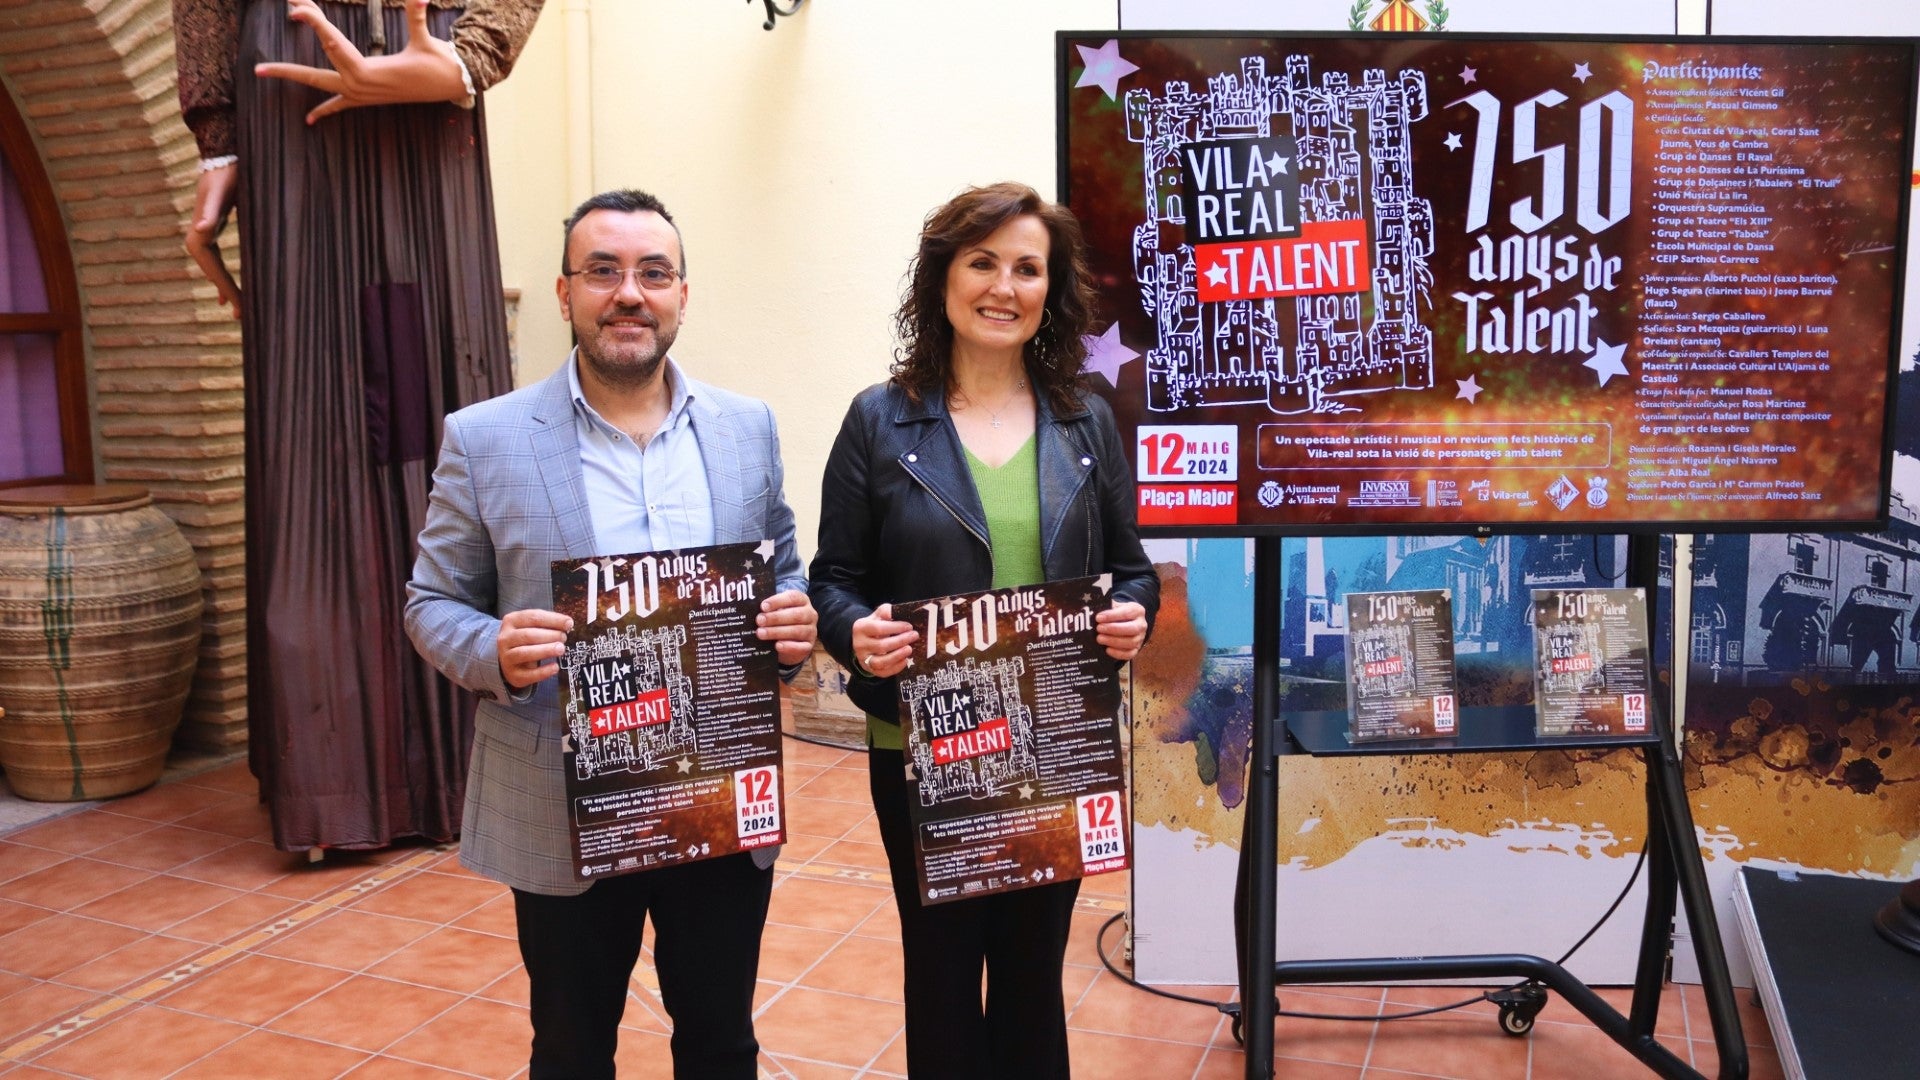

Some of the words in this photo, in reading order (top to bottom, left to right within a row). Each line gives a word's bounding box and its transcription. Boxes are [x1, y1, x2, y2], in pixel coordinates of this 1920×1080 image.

[1643, 60, 1762, 85] Participants:
[1739, 89, 1769, 97] Vicent
[1771, 89, 1784, 97] Gil
[1706, 102, 1739, 110] Pascual
[1742, 102, 1778, 110] Gimeno
[1682, 127, 1711, 136] Ciutat
[1713, 127, 1724, 135] de
[1727, 127, 1769, 136] Vila-real,
[1771, 128, 1796, 136] Coral
[1799, 128, 1820, 136] Sant
[1660, 140, 1692, 149] Jaume,
[1695, 140, 1716, 148] Veus
[1719, 140, 1730, 148] de
[1732, 140, 1768, 149] Cambra
[1660, 153, 1683, 162] Grup
[1685, 153, 1697, 161] de
[1700, 153, 1731, 161] Danses
[1737, 153, 1745, 161] El
[1748, 153, 1773, 162] Raval
[1186, 145, 1270, 192] VILA
[1660, 166, 1683, 175] Grup
[1685, 166, 1696, 174] de
[1699, 166, 1731, 174] Danses
[1733, 166, 1745, 174] de
[1747, 166, 1758, 174] La
[1761, 166, 1805, 175] Puríssima
[1659, 178, 1682, 188] Grup
[1684, 178, 1696, 186] de
[1698, 179, 1746, 189] Dolçainers
[1754, 179, 1792, 187] Tabalers
[1658, 191, 1680, 199] Unió
[1683, 191, 1716, 200] Musical
[1719, 192, 1730, 200] La
[1199, 190, 1295, 238] REAL
[1658, 204, 1705, 214] Orquestra
[1708, 204, 1765, 214] Supramúsica
[1657, 217, 1680, 226] Grup
[1683, 217, 1694, 225] de
[1697, 217, 1727, 225] Teatre
[1657, 229, 1680, 239] Grup
[1682, 229, 1694, 238] de
[1696, 230, 1727, 238] Teatre
[1657, 242, 1685, 250] Escola
[1687, 242, 1731, 251] Municipal
[1747, 243, 1774, 251] Dansa
[1656, 255, 1678, 263] CEIP
[1681, 255, 1716, 263] Sarthou
[1719, 255, 1759, 264] Carreres
[1222, 239, 1360, 294] TALENT
[1469, 234, 1579, 298] anys
[1584, 243, 1622, 291] de
[1645, 300, 1677, 309] (flauta)
[1451, 289, 1599, 354] Talent
[1691, 313, 1720, 322] Sergio
[1723, 313, 1766, 321] Caballero
[1643, 337, 1678, 345] Orelans
[1681, 337, 1721, 347] (cantant)
[1643, 362, 1683, 370] Maestrat
[1690, 362, 1736, 370] Associació
[1739, 362, 1776, 371] Cultural
[1819, 363, 1830, 371] de
[1641, 375, 1678, 383] Castelló
[1746, 388, 1772, 396] Rodas
[1742, 400, 1763, 408] Rosa
[1766, 400, 1806, 408] Martínez
[1276, 436, 1291, 444] Un
[1294, 435, 1351, 447] espectacle
[1354, 435, 1392, 444] artístic
[1401, 435, 1441, 444] musical
[1444, 436, 1457, 444] on
[1461, 435, 1508, 444] reviurem
[1511, 435, 1531, 444] fets
[1534, 435, 1578, 444] històrics
[1582, 435, 1594, 444] de
[1140, 433, 1185, 475] 12
[1187, 442, 1230, 454] MAIG
[1308, 449, 1354, 458] Vila-real
[1357, 449, 1379, 458] sota
[1382, 449, 1392, 458] la
[1395, 449, 1419, 458] visió
[1422, 449, 1435, 458] de
[1438, 450, 1502, 460] personatges
[1505, 449, 1527, 458] amb
[1531, 449, 1562, 458] talent
[1188, 460, 1228, 474] 2024
[1286, 485, 1340, 494] Ajuntament
[1493, 491, 1529, 499] Vila-real
[1141, 489, 1186, 509] Plaça
[1188, 489, 1234, 508] Major
[1297, 495, 1336, 504] Vila-real
[1765, 492, 1798, 500] Alfredo
[659, 554, 707, 579] anys
[677, 578, 693, 599] de
[691, 574, 756, 606] Talent
[998, 589, 1045, 613] anys
[1015, 612, 1032, 633] de
[1031, 606, 1093, 637] Talent
[1362, 642, 1380, 651] VILA
[1550, 638, 1568, 648] VILA
[1365, 651, 1386, 662] REAL
[1552, 649, 1574, 659] REAL
[1371, 661, 1401, 675] TALENT
[1559, 659, 1590, 671] TALENT
[583, 661, 622, 686] VILA
[590, 680, 635, 707] REAL
[924, 693, 962, 717] VILA
[1436, 697, 1451, 712] 12
[1627, 696, 1642, 710] 12
[602, 698, 667, 731] TALENT
[932, 711, 976, 737] REAL
[944, 727, 1007, 760] TALENT
[740, 770, 772, 804] 12
[742, 803, 774, 817] MAIG
[1083, 796, 1115, 829] 12
[744, 816, 774, 832] 2024
[760, 834, 779, 845] Major
[1085, 828, 1118, 842] MAIG
[1087, 841, 1118, 857] 2024
